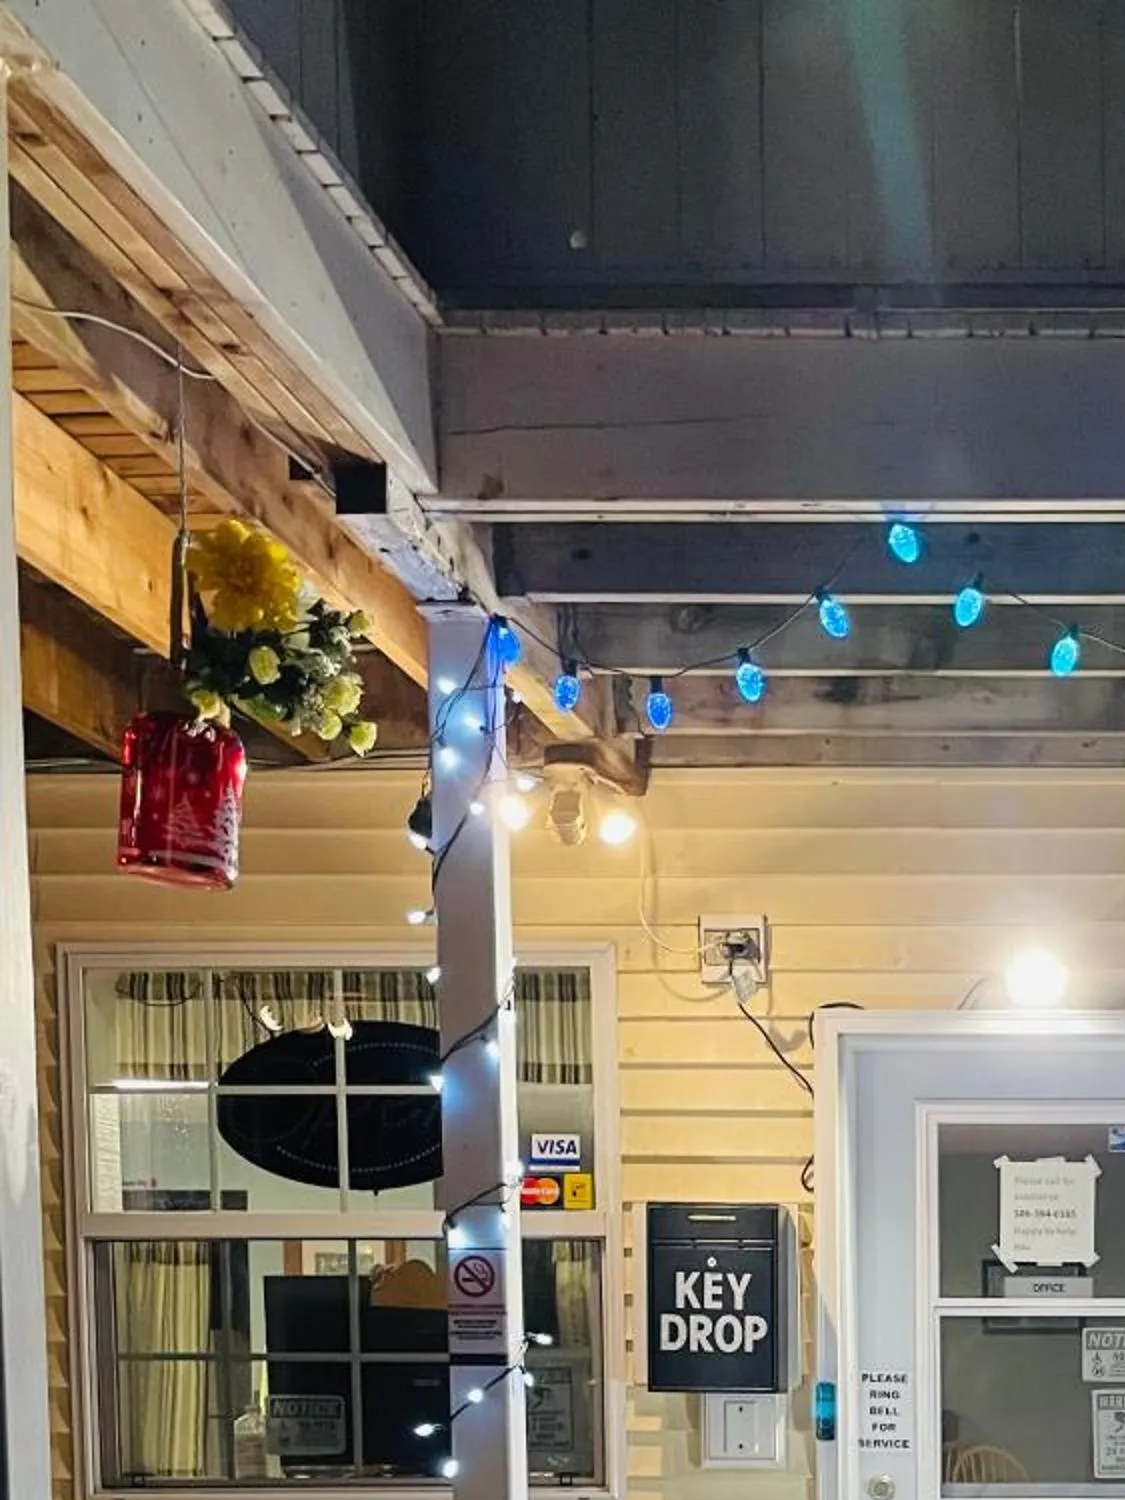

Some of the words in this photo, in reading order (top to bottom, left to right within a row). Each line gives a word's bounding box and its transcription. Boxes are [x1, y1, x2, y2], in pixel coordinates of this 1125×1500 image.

[537, 1139, 577, 1155] VISA
[675, 1271, 753, 1311] KEY
[1033, 1282, 1067, 1293] OFFICE
[660, 1313, 769, 1353] DROP
[861, 1373, 908, 1383] PLEASE
[869, 1390, 901, 1400] RING
[273, 1399, 338, 1416] NOTICE
[869, 1406, 900, 1417] BELL
[872, 1423, 897, 1432] FOR
[858, 1438, 910, 1449] SERVICE
